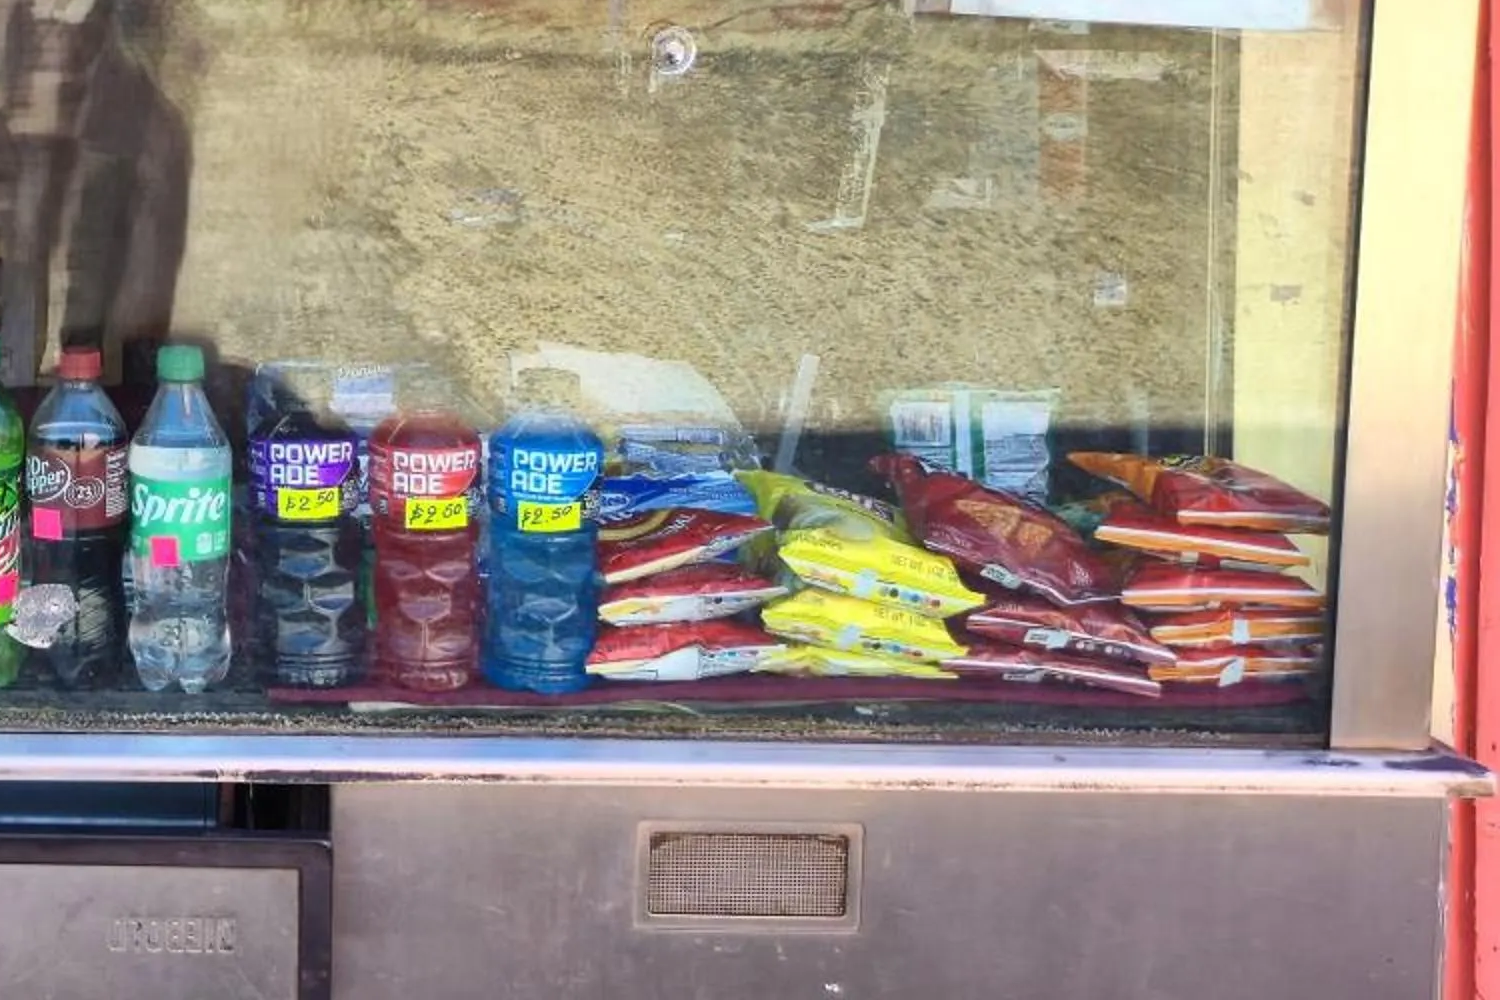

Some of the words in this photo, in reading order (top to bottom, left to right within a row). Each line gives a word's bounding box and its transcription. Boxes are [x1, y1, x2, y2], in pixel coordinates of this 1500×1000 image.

[270, 441, 353, 464] POWER
[393, 449, 477, 473] POWER
[512, 449, 597, 473] POWER
[30, 457, 49, 477] Dr
[270, 464, 321, 486] ADE
[75, 485, 93, 498] 23
[392, 473, 445, 495] ADE
[510, 472, 564, 495] ADE
[131, 481, 227, 527] Sprite
